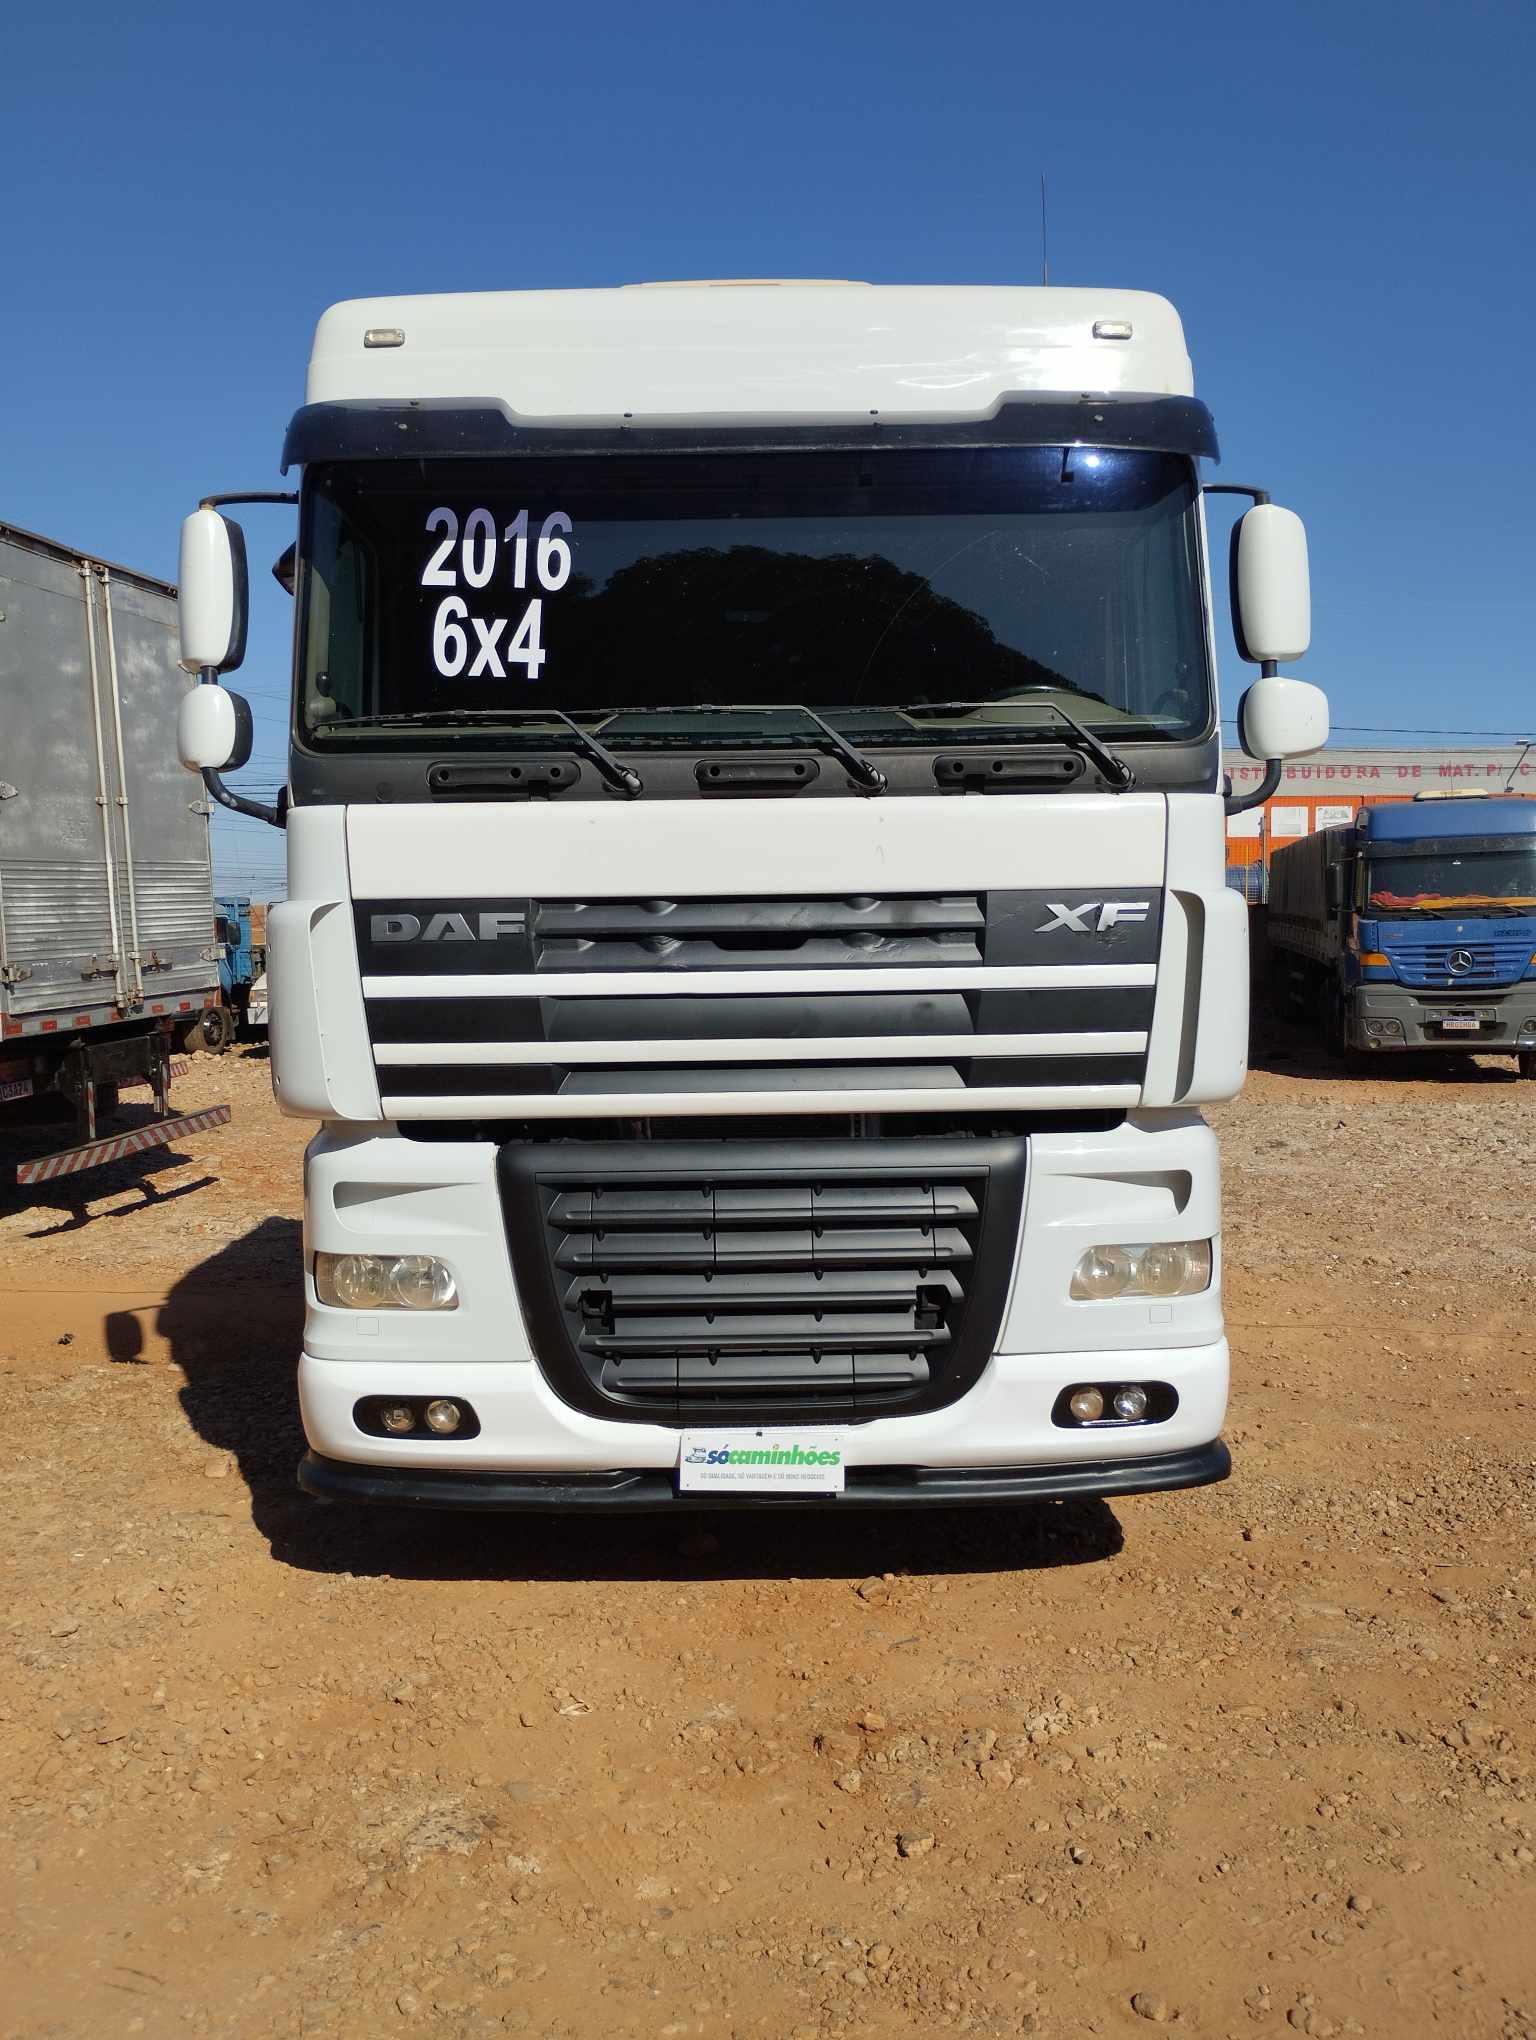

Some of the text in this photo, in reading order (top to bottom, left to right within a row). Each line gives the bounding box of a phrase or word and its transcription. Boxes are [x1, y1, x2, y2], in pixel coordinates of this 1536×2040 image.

[421, 507, 572, 591] 2016
[433, 595, 545, 679] 6x4
[1398, 764, 1421, 778] DE
[1439, 764, 1479, 777] MAT.
[370, 912, 525, 942] DAF
[1034, 902, 1150, 932] XF
